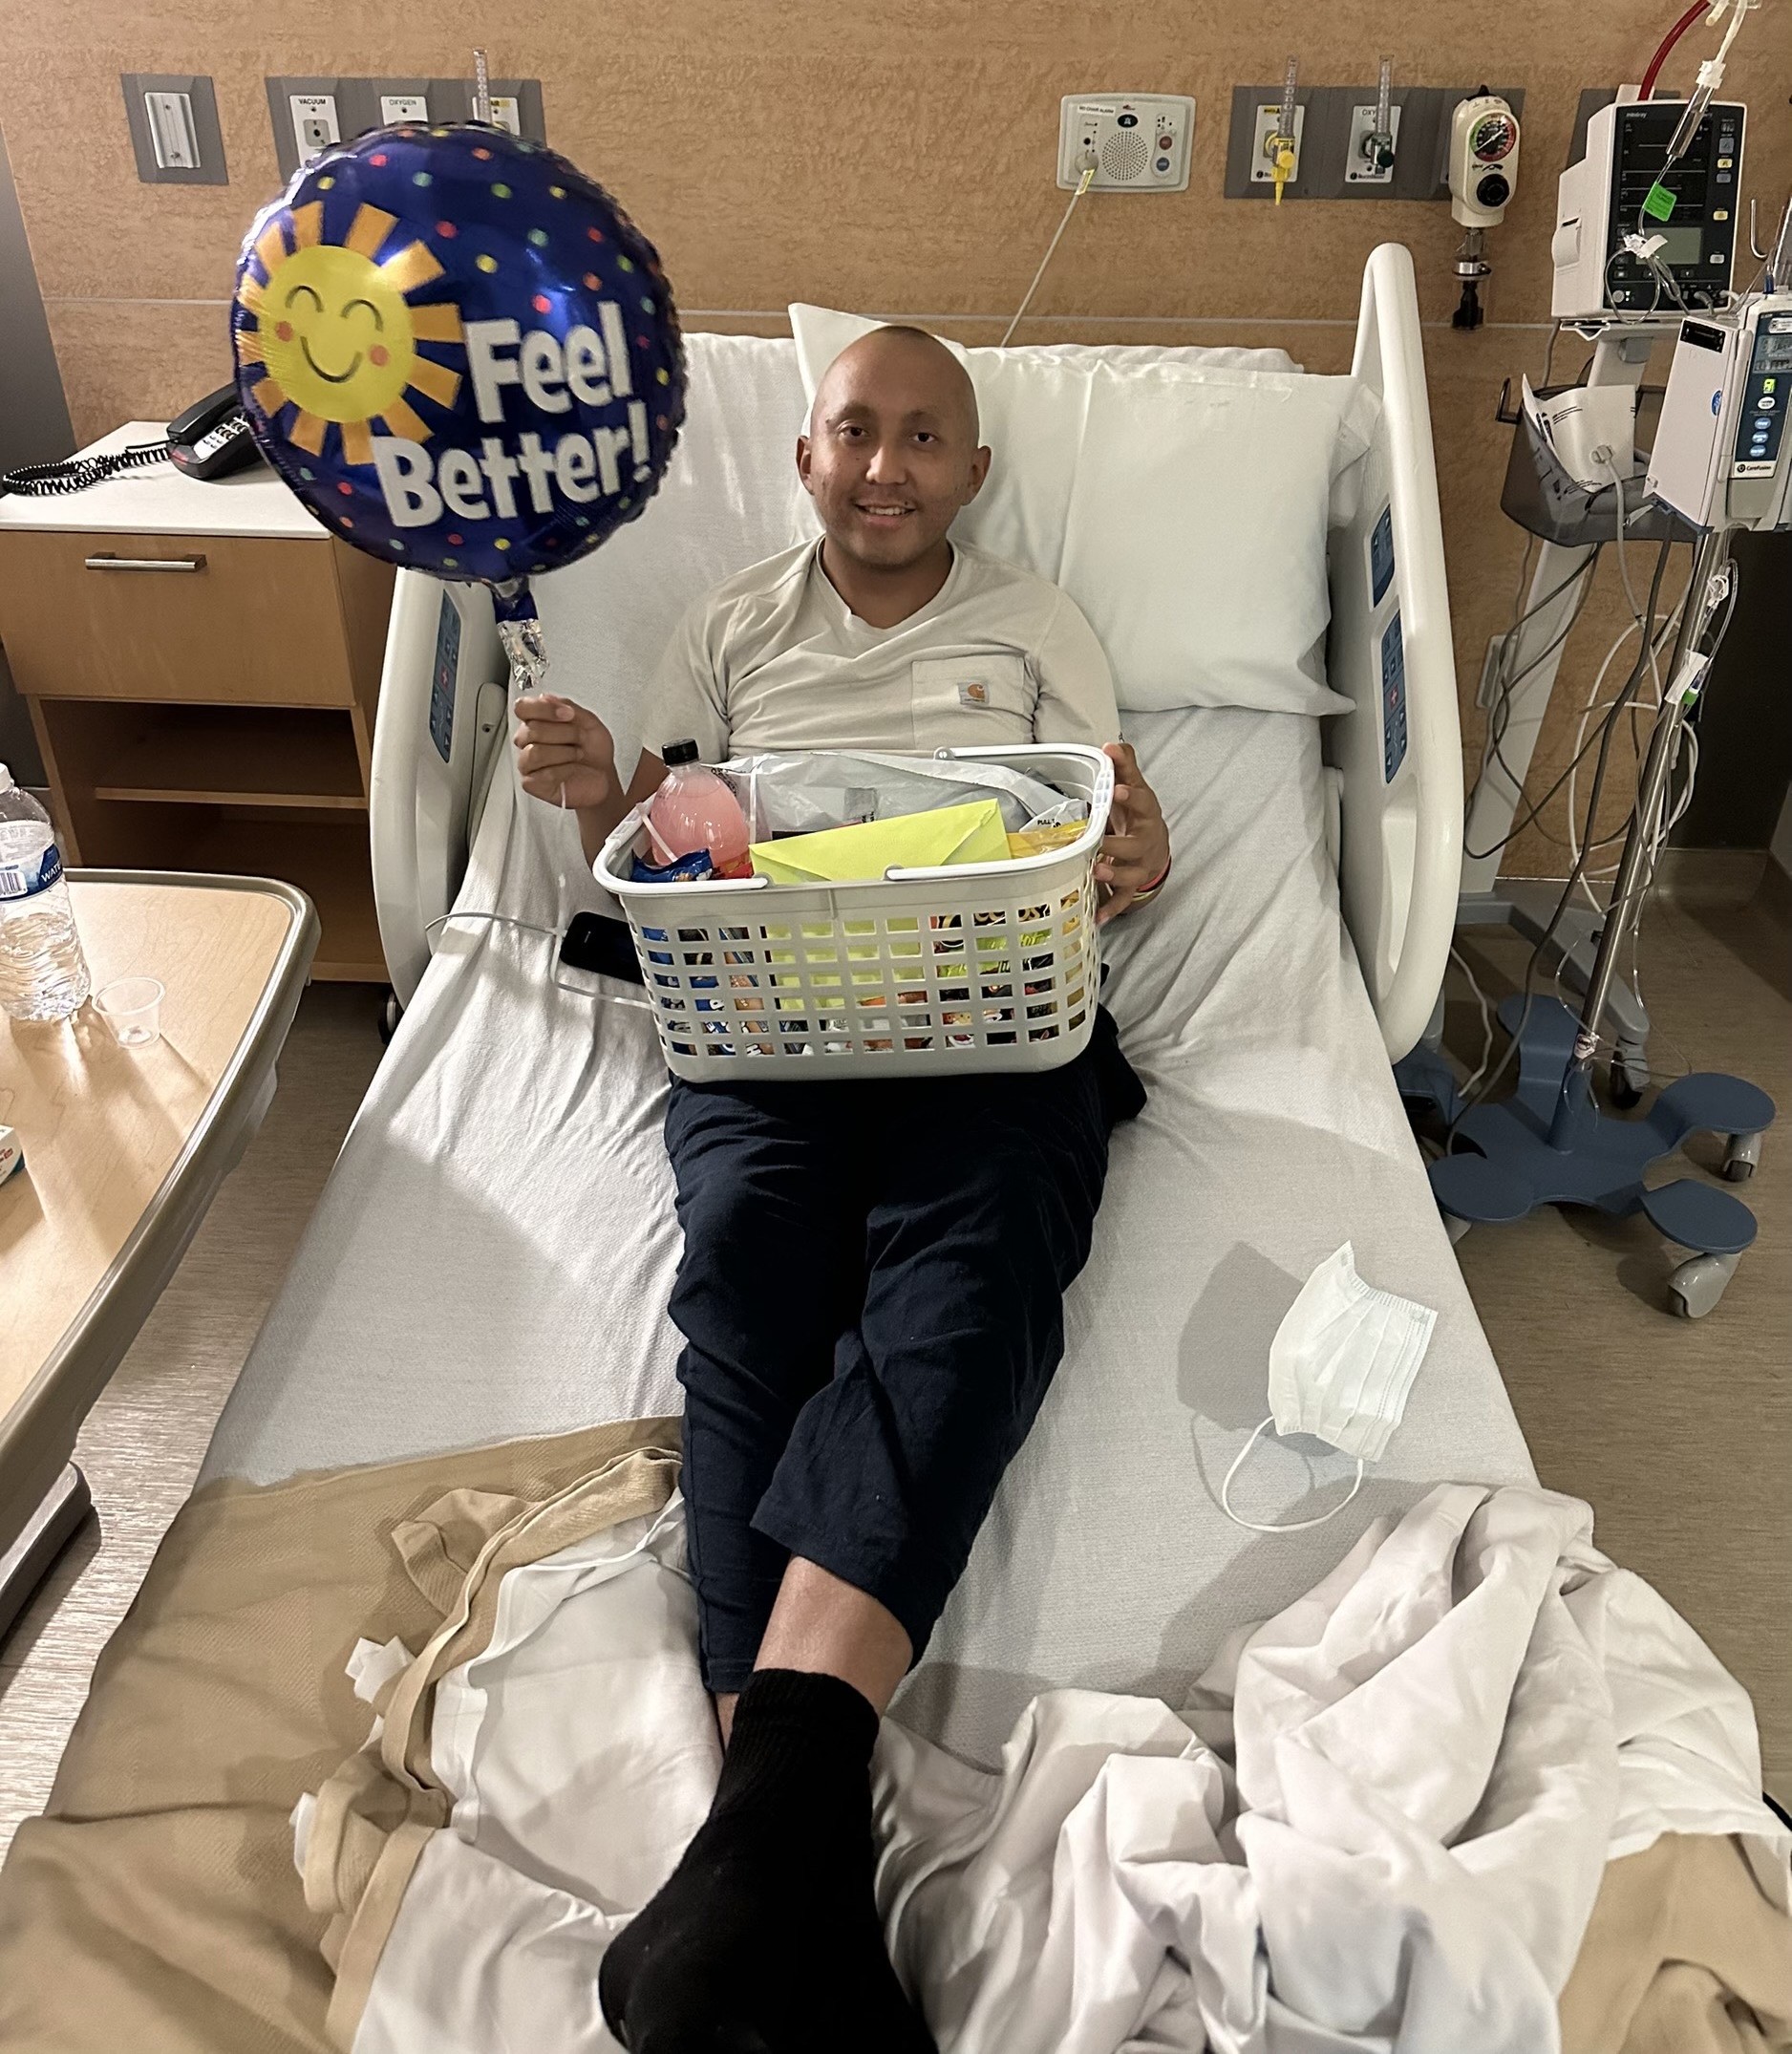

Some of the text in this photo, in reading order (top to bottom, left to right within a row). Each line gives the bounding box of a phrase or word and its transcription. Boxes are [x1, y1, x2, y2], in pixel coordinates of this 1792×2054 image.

[464, 300, 633, 424] Feel
[371, 399, 652, 528] Better!
[41, 860, 61, 882] WATE
